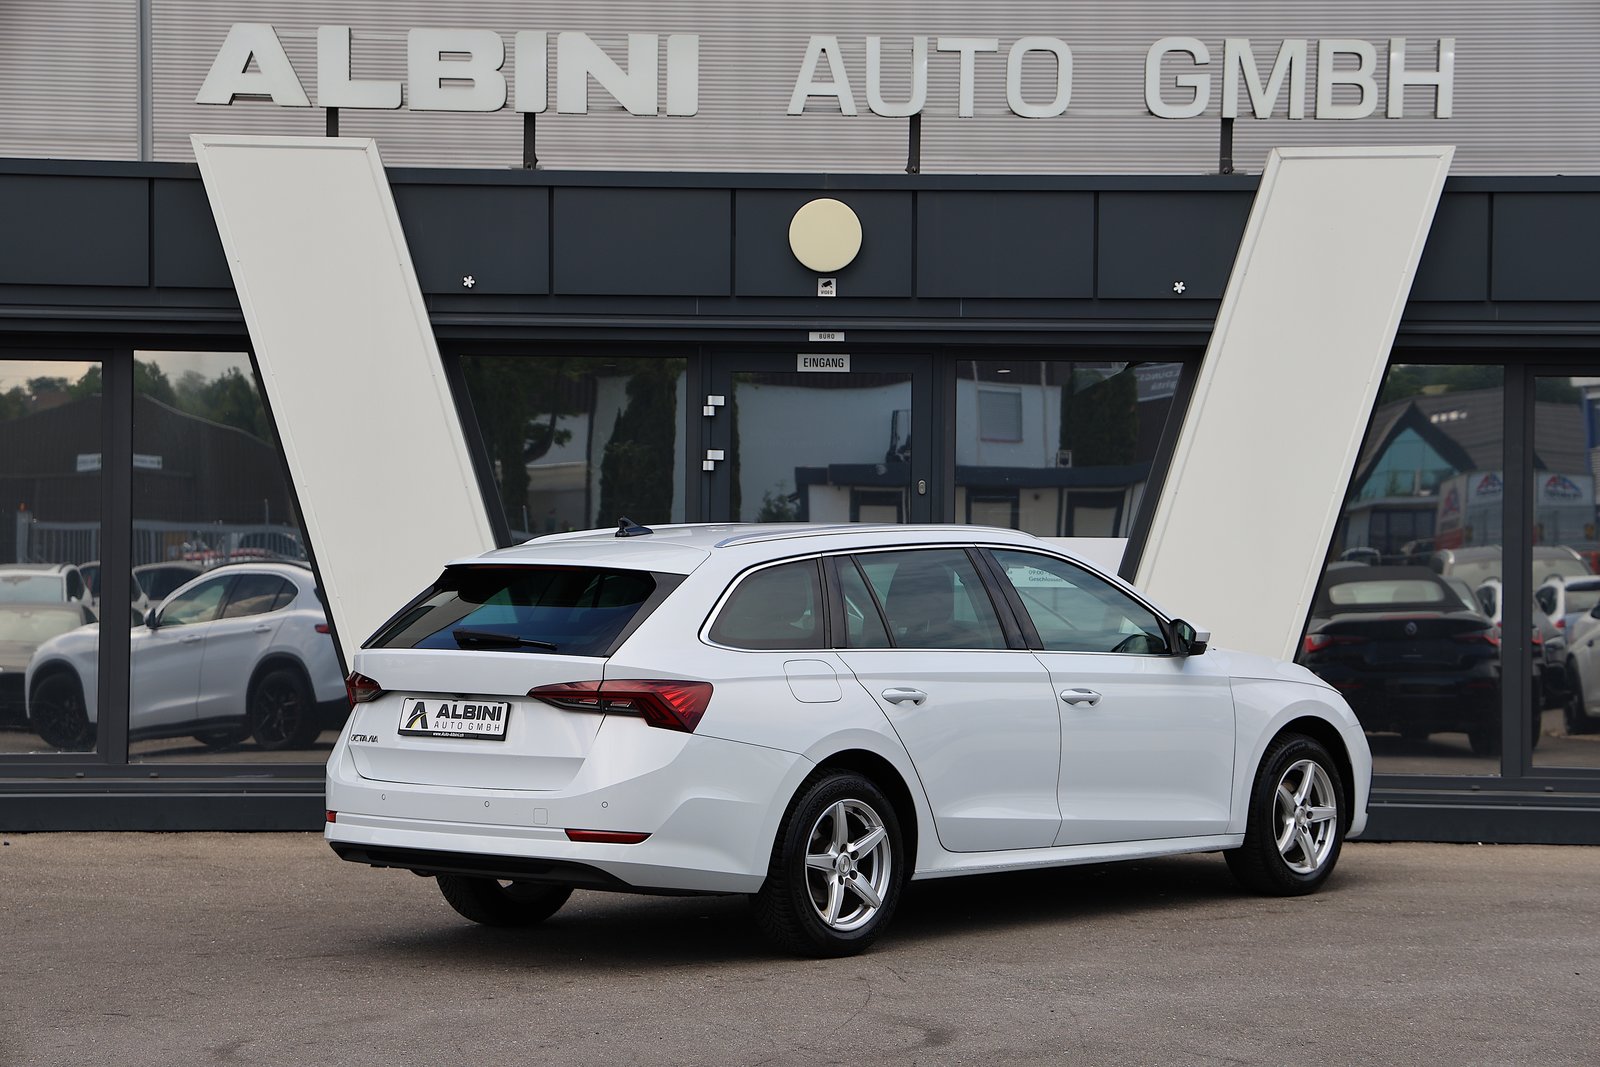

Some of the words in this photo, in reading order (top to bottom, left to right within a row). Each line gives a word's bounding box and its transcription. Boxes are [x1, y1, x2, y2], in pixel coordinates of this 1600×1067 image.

[194, 23, 699, 117] ALBINI
[787, 36, 1073, 118] AUTO
[1144, 36, 1455, 119] GMBH
[803, 357, 844, 368] EINGANG
[435, 703, 503, 721] ALBINI
[433, 720, 463, 731] AUTO
[468, 722, 501, 732] GMBH
